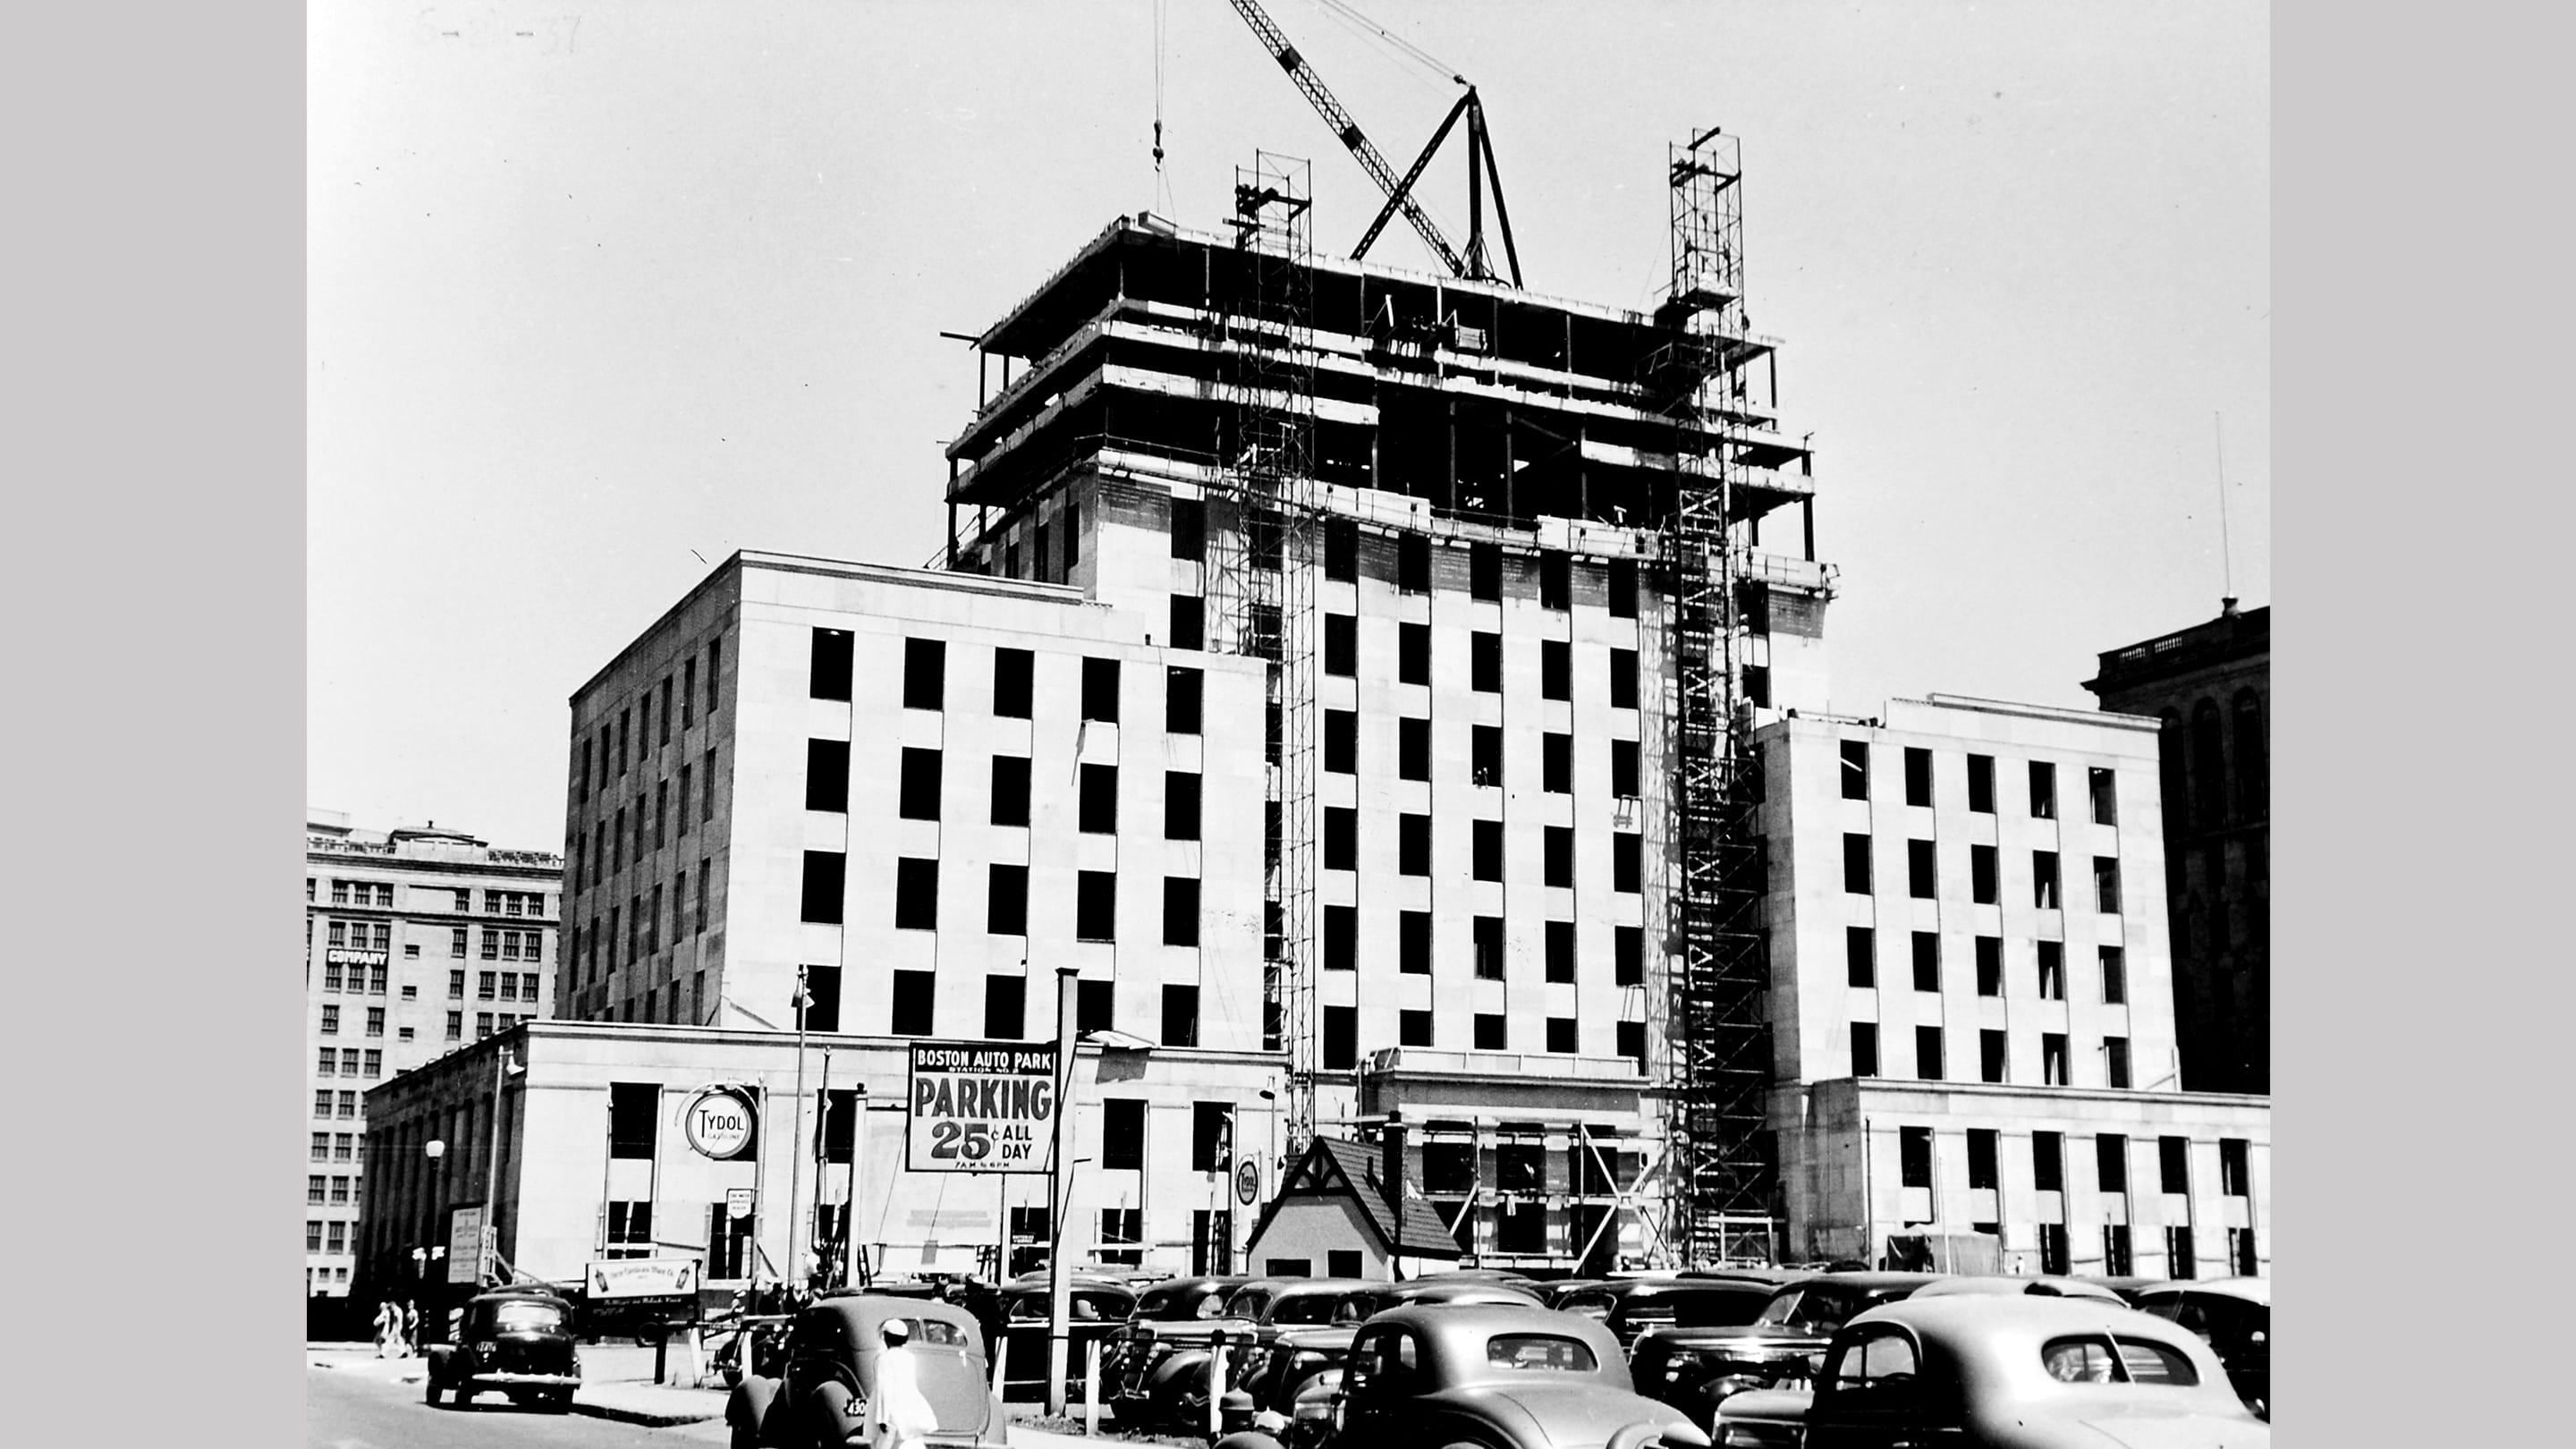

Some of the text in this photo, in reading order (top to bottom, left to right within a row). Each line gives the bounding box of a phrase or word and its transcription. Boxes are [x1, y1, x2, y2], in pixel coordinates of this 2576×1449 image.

[328, 950, 387, 965] COMPANY
[918, 1049, 1051, 1070] BOSTON AUTO PARK
[915, 1078, 1052, 1121] PARKING
[699, 1109, 744, 1139] TYDOL
[1003, 1124, 1032, 1140] ALL
[1003, 1144, 1032, 1160] DAY
